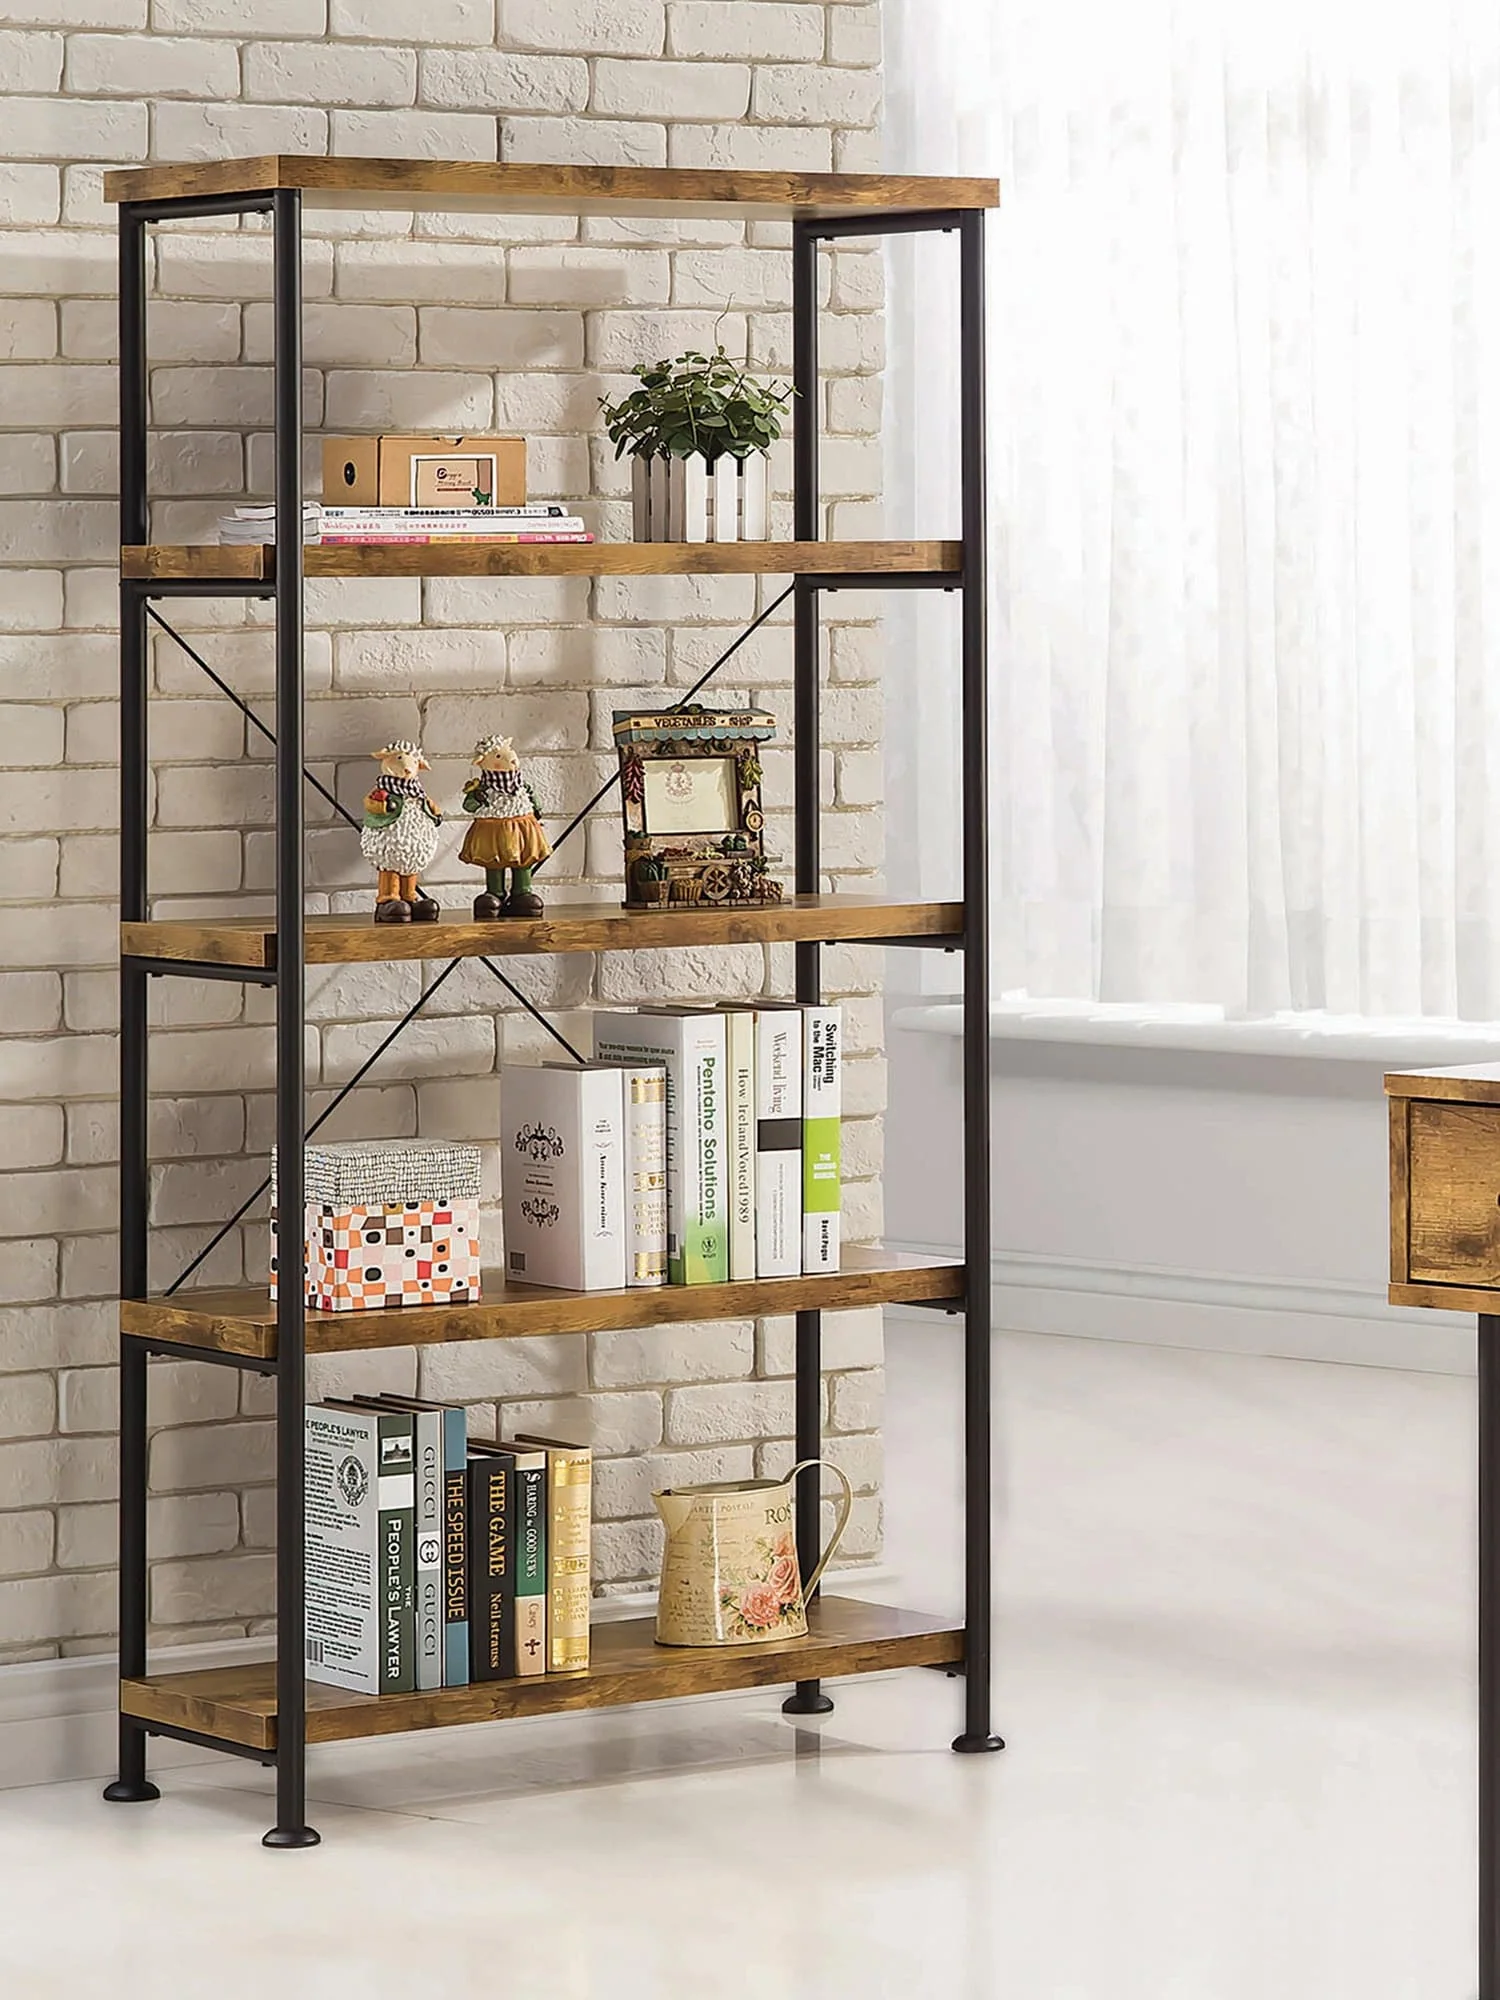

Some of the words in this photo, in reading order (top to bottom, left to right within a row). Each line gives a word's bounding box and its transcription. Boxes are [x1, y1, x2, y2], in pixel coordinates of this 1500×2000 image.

[654, 716, 716, 728] VEGETABLES
[728, 716, 753, 727] SHOP
[813, 1020, 821, 1029] to
[813, 1031, 821, 1043] the
[772, 1031, 787, 1080] Weekend
[813, 1047, 825, 1073] Mac
[822, 1023, 837, 1084] Switching
[702, 1057, 716, 1130] Pentaho
[737, 1069, 749, 1098] How
[768, 1084, 787, 1114] living
[704, 1138, 718, 1219] Solutions
[821, 1220, 829, 1239] David
[311, 1421, 341, 1435] PEOPLE'S
[341, 1426, 369, 1440] LAWYER
[424, 1446, 436, 1520] GUCCI
[447, 1475, 464, 1509] THE
[488, 1471, 506, 1513] THE
[522, 1471, 541, 1517] SHARING
[447, 1511, 465, 1564] SPEED
[488, 1516, 506, 1577] GAME
[525, 1528, 538, 1553] GOOD
[388, 1519, 403, 1602] PEOPLE'S
[525, 1553, 538, 1577] NEWS
[448, 1567, 465, 1618] ISSUE
[490, 1592, 503, 1619] Neil
[424, 1583, 436, 1657] GUCCI
[387, 1607, 402, 1679] LAWYER
[490, 1621, 502, 1668] strauss
